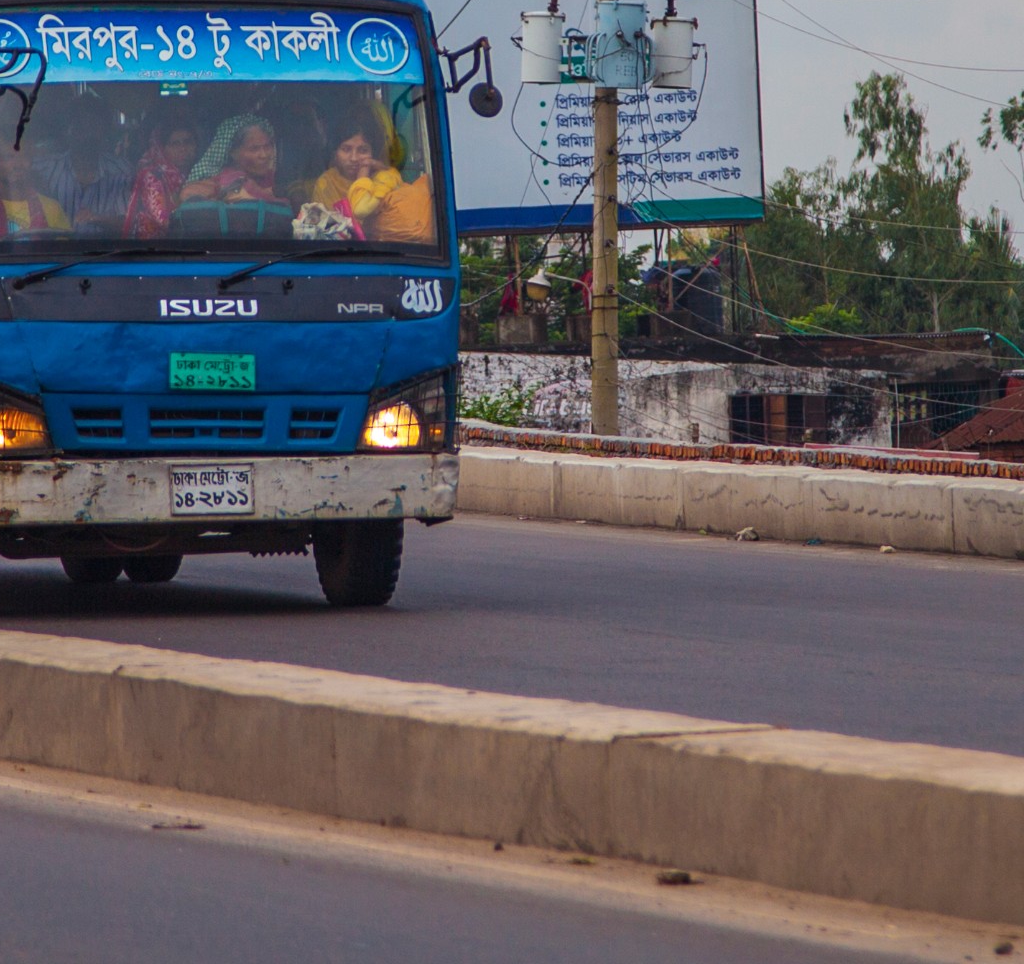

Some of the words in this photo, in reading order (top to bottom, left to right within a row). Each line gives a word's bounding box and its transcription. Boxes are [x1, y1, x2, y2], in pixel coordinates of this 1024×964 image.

[36, 13, 197, 72] মিরপুর-১৪
[206, 13, 232, 73] টু
[240, 12, 341, 62] কাকলী
[556, 93, 594, 109] প্রিমিয়া
[654, 89, 697, 103] একাউন্ট
[556, 113, 594, 128] প্রিমিয়া
[557, 133, 594, 148] প্রিমিয়া
[558, 153, 594, 167] প্রিমিয়া
[696, 146, 740, 161] একাউন্ট
[559, 172, 595, 187] প্রিমিয়া
[698, 166, 742, 181] একাউন্ট
[160, 299, 258, 317] ISUZU
[338, 303, 384, 314] NPR
[176, 360, 200, 371] ঢাকা
[174, 374, 252, 388] ১৪-২৮১১
[173, 471, 197, 486] ঢাকা
